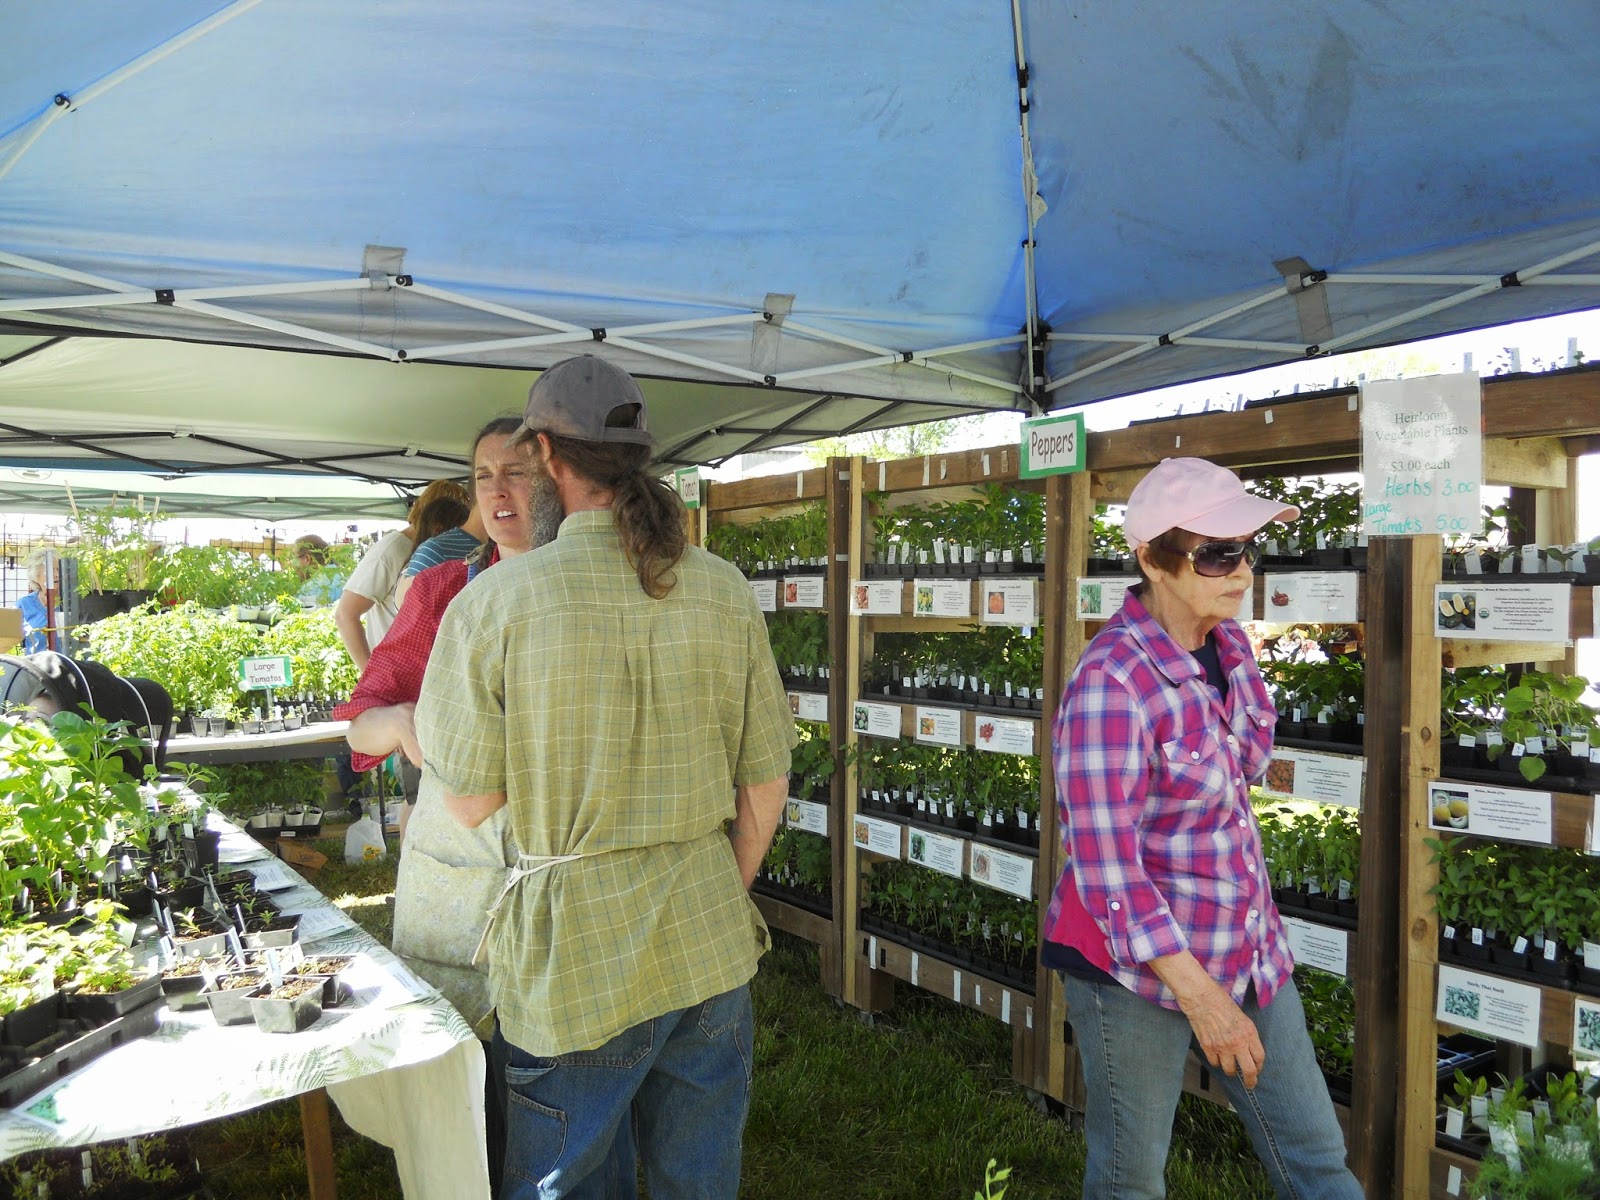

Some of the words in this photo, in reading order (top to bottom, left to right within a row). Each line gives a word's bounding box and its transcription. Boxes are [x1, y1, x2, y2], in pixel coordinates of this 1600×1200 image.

[1395, 411, 1448, 424] Heirloom
[1375, 428, 1431, 442] Vegetable
[1434, 425, 1468, 437] Plants
[1031, 431, 1074, 464] Peppers
[1391, 460, 1421, 473] $3.00
[1424, 458, 1450, 470] each
[1385, 475, 1432, 498] Herbs
[1441, 478, 1475, 497] 3.00
[1364, 502, 1392, 521] Large
[1435, 512, 1469, 531] 5.00
[253, 662, 276, 671] Large
[249, 674, 282, 683] Tomatos
